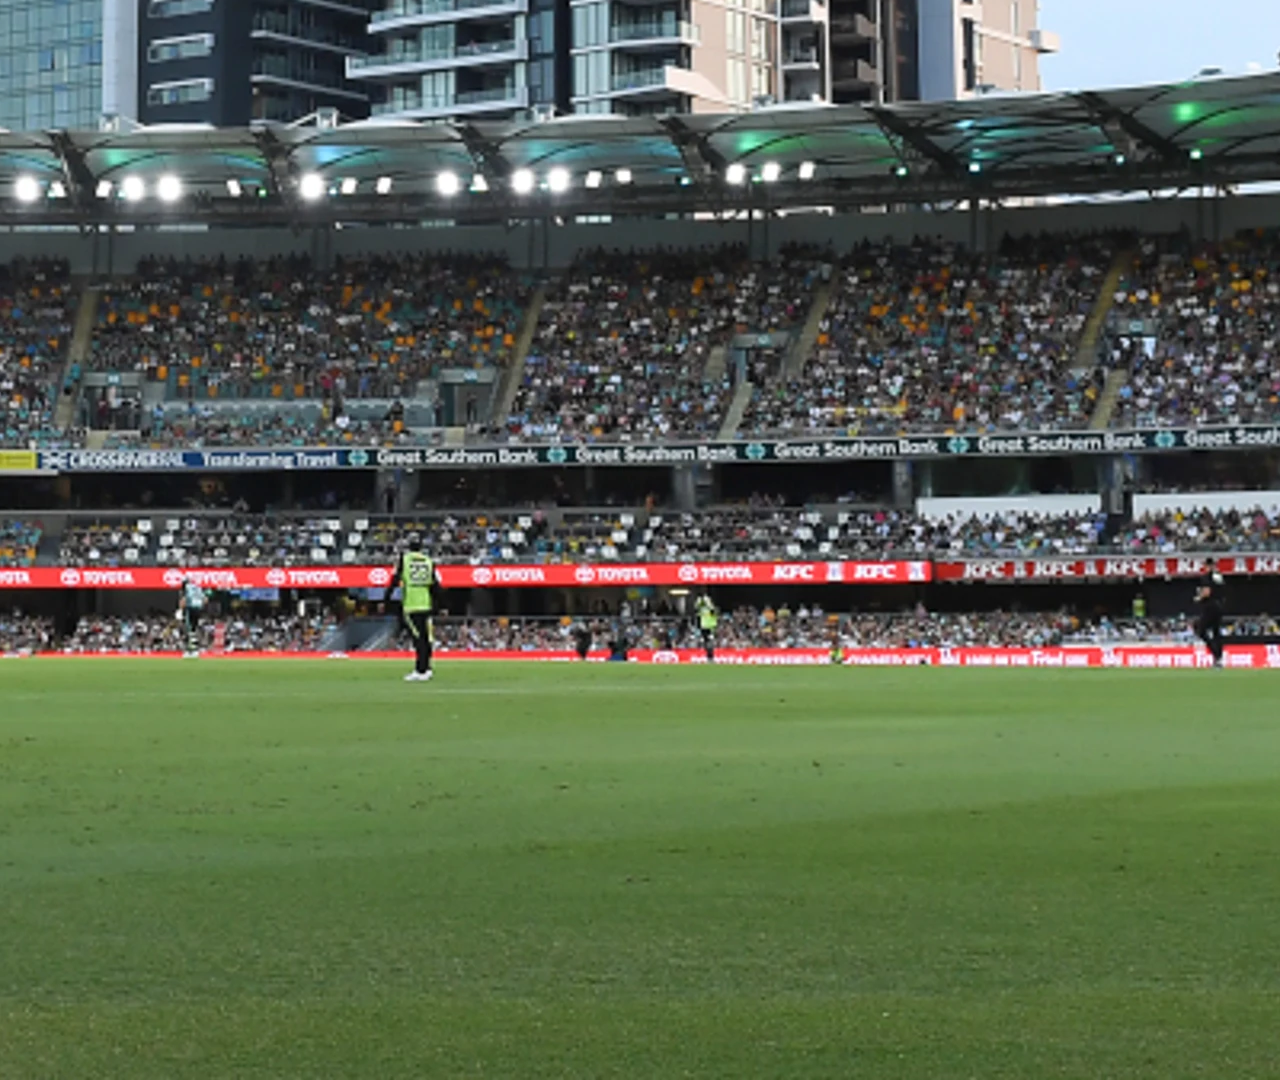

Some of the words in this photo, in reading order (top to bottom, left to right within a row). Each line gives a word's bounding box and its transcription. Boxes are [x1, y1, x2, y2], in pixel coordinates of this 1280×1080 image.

[978, 434, 1026, 452] Great
[1031, 431, 1102, 450] Southern
[1105, 428, 1147, 446] Bank
[1183, 427, 1231, 444] Great
[575, 447, 620, 463] Great
[624, 446, 694, 463] Southern
[697, 443, 737, 460] Bank
[774, 442, 819, 457] Great
[824, 439, 896, 457] Southern
[899, 436, 939, 454] Bank
[202, 452, 294, 471] Transforming
[297, 450, 338, 466] Travel
[376, 449, 421, 464] Great
[425, 448, 494, 467] Southern
[498, 448, 538, 465] Bank
[495, 569, 544, 581] TOYOTA
[598, 568, 647, 580] TOYOTA
[701, 567, 752, 579] TOYOTA
[773, 565, 813, 579] KFC
[854, 565, 896, 578] KFC
[965, 561, 1004, 577] KFC
[1034, 561, 1074, 576] KFC
[1105, 559, 1144, 575] KFC
[1176, 559, 1210, 575] KF
[83, 571, 133, 584] TOYOTA
[289, 571, 339, 583] TOYOTA
